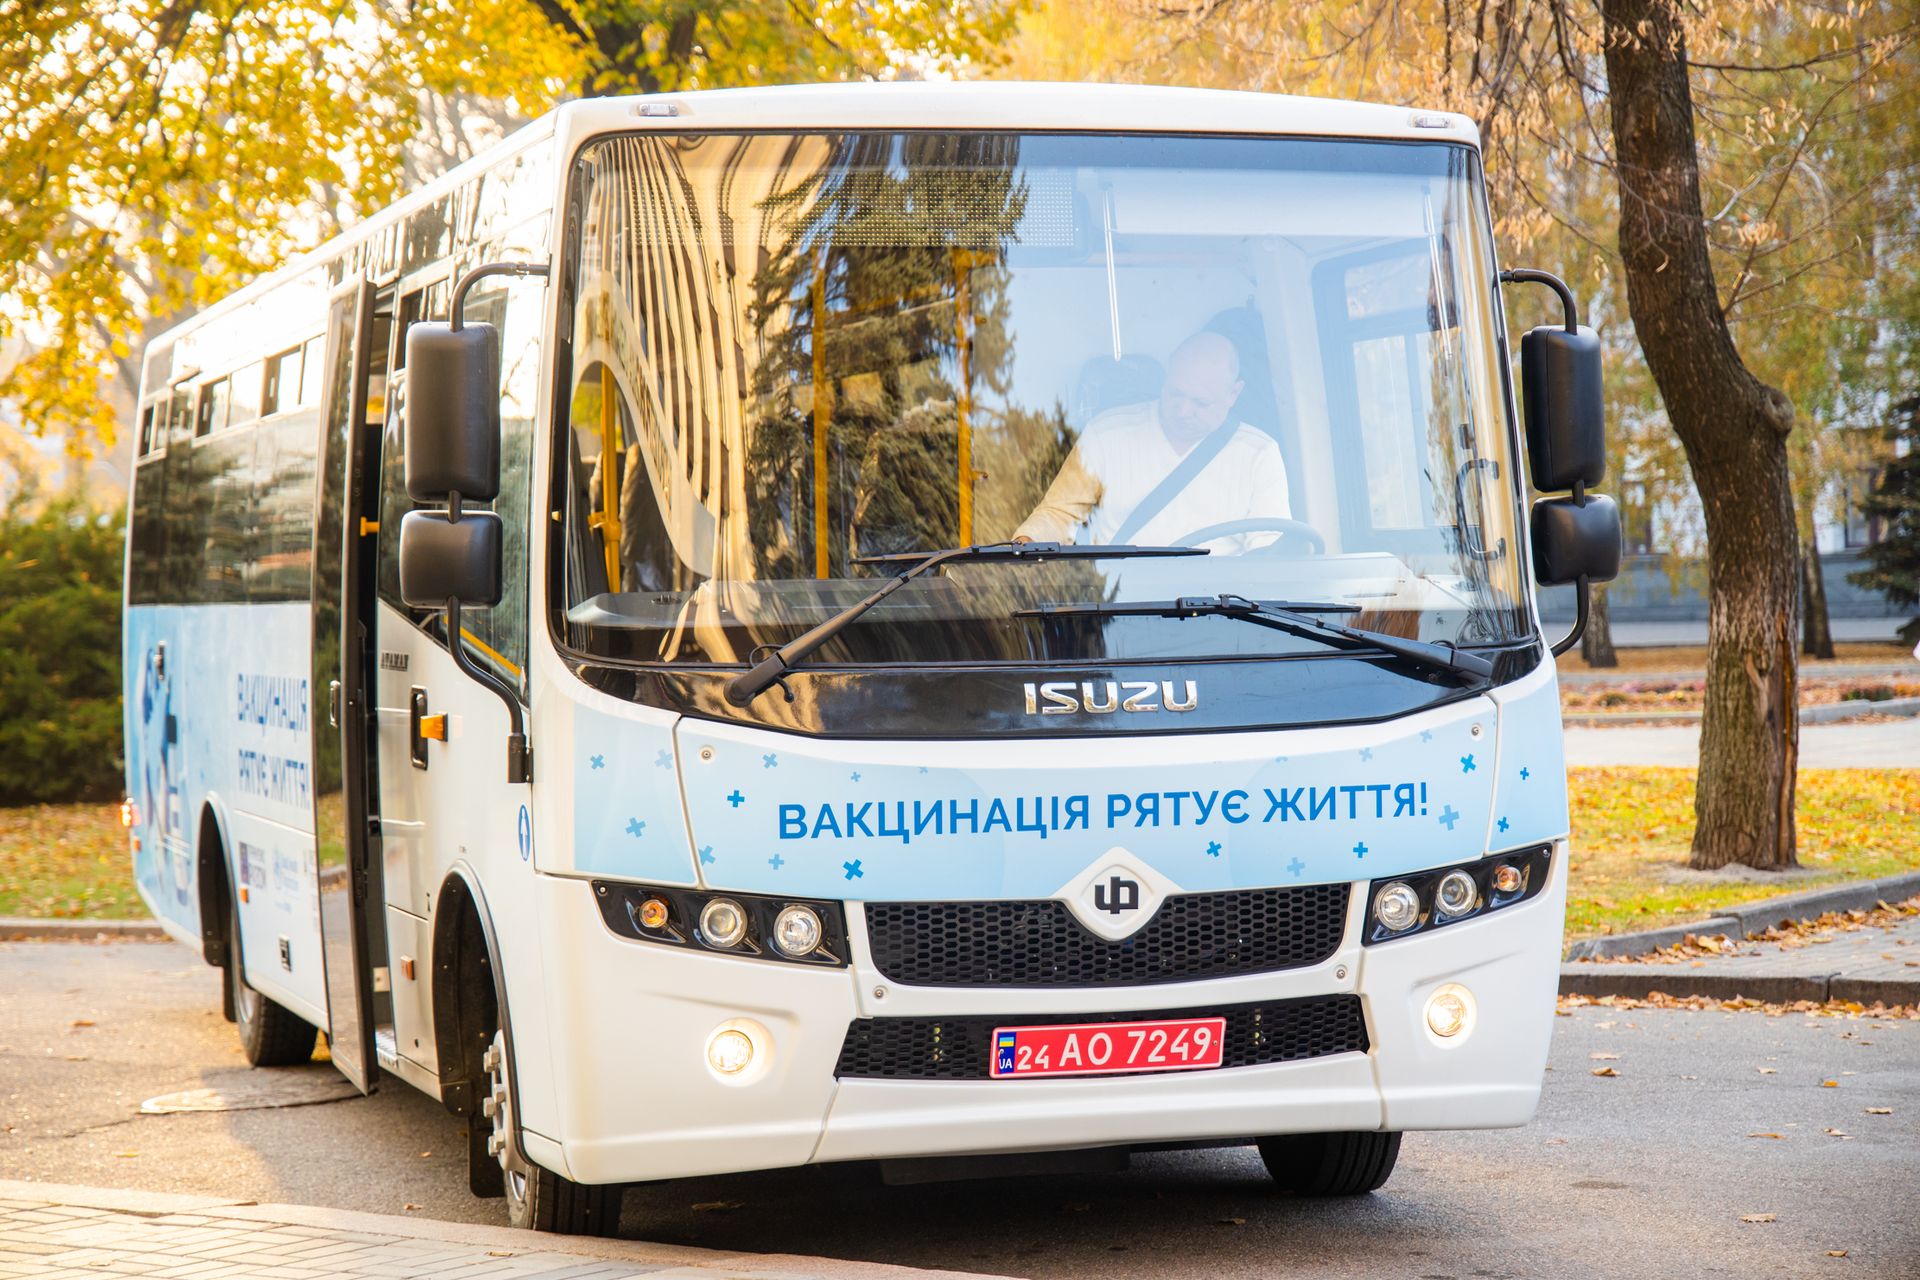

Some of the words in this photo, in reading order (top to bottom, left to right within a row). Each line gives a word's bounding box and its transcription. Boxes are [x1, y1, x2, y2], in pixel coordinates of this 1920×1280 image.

[1023, 679, 1198, 716] ISUZU
[780, 796, 1088, 844] ВАКЦИНАЦІЯ
[1108, 790, 1248, 828] РЯТУЄ
[1264, 783, 1426, 822] ЖИТТЯ!
[998, 1058, 1013, 1069] UA
[1017, 1044, 1050, 1071] 24
[1058, 1032, 1113, 1067] AO
[1126, 1026, 1212, 1065] 7249
